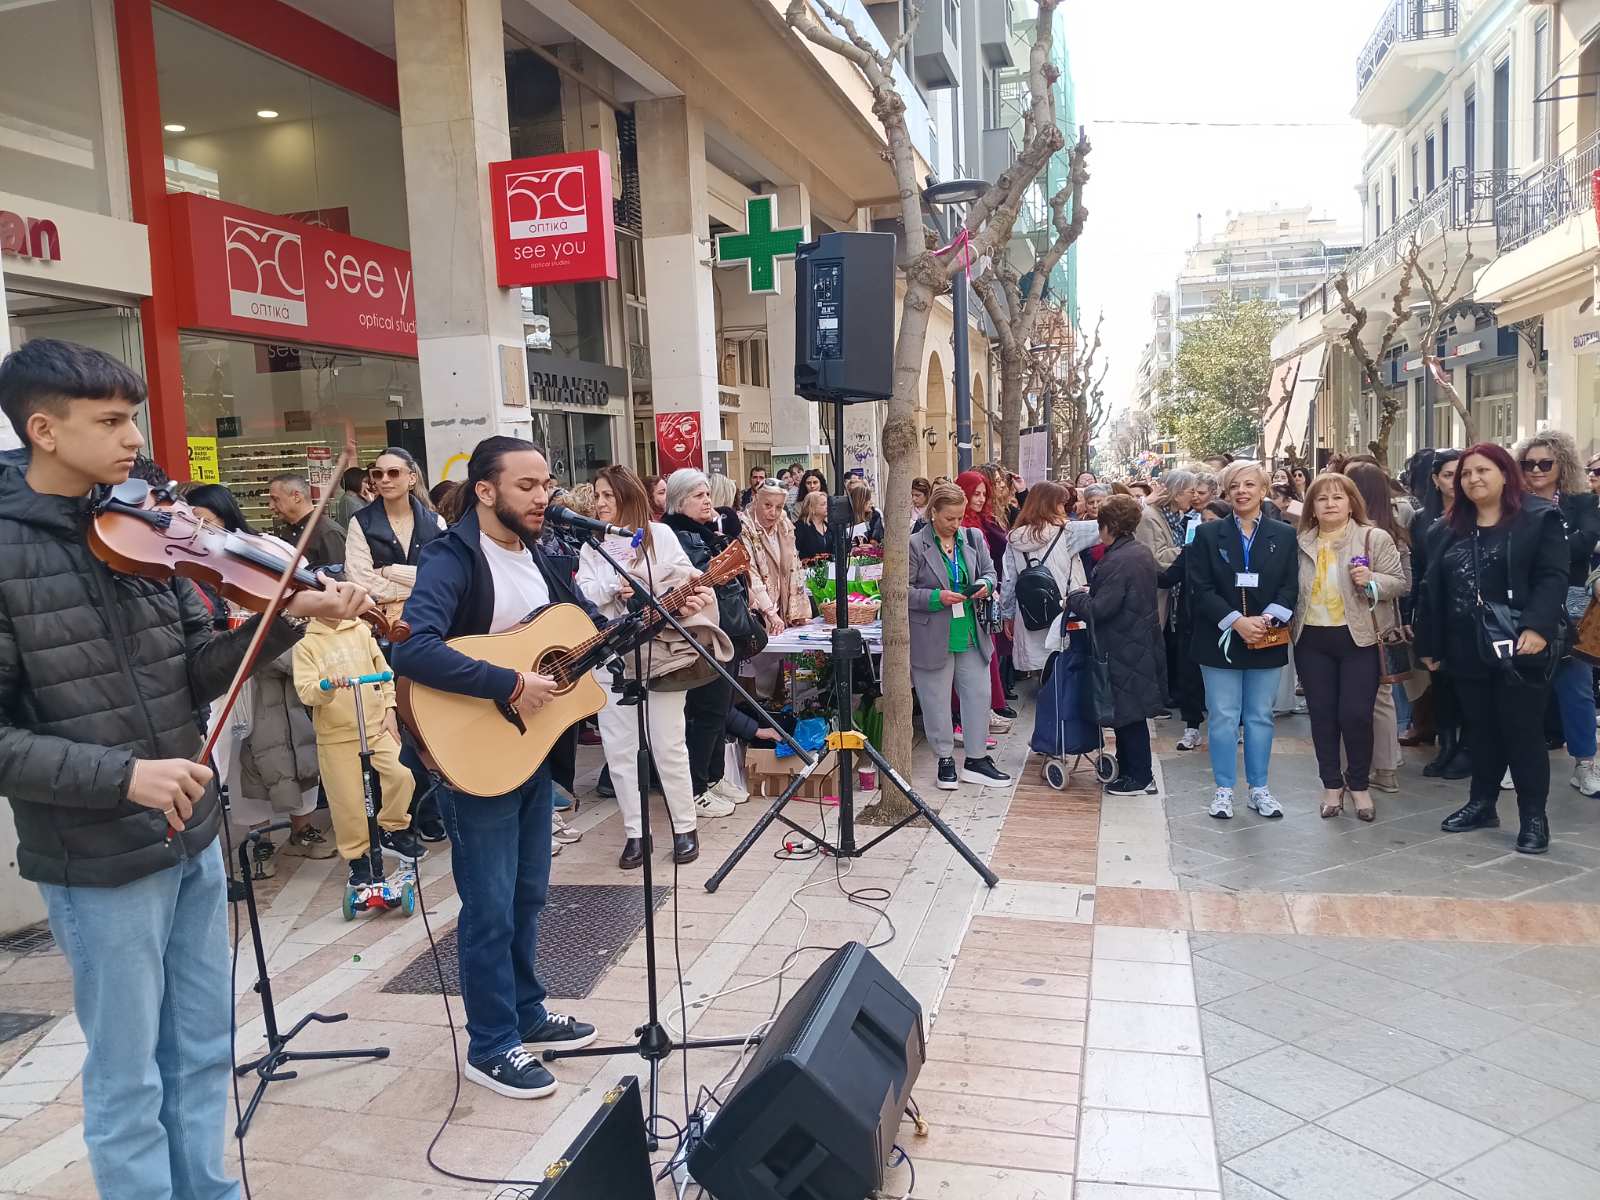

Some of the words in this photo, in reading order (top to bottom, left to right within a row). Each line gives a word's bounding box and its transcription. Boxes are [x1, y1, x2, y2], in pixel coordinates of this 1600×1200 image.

[528, 219, 568, 234] οπτικά
[514, 244, 546, 260] see
[552, 241, 586, 260] you
[324, 250, 384, 298] see
[251, 302, 290, 320] οπτικά
[359, 312, 394, 330] optical
